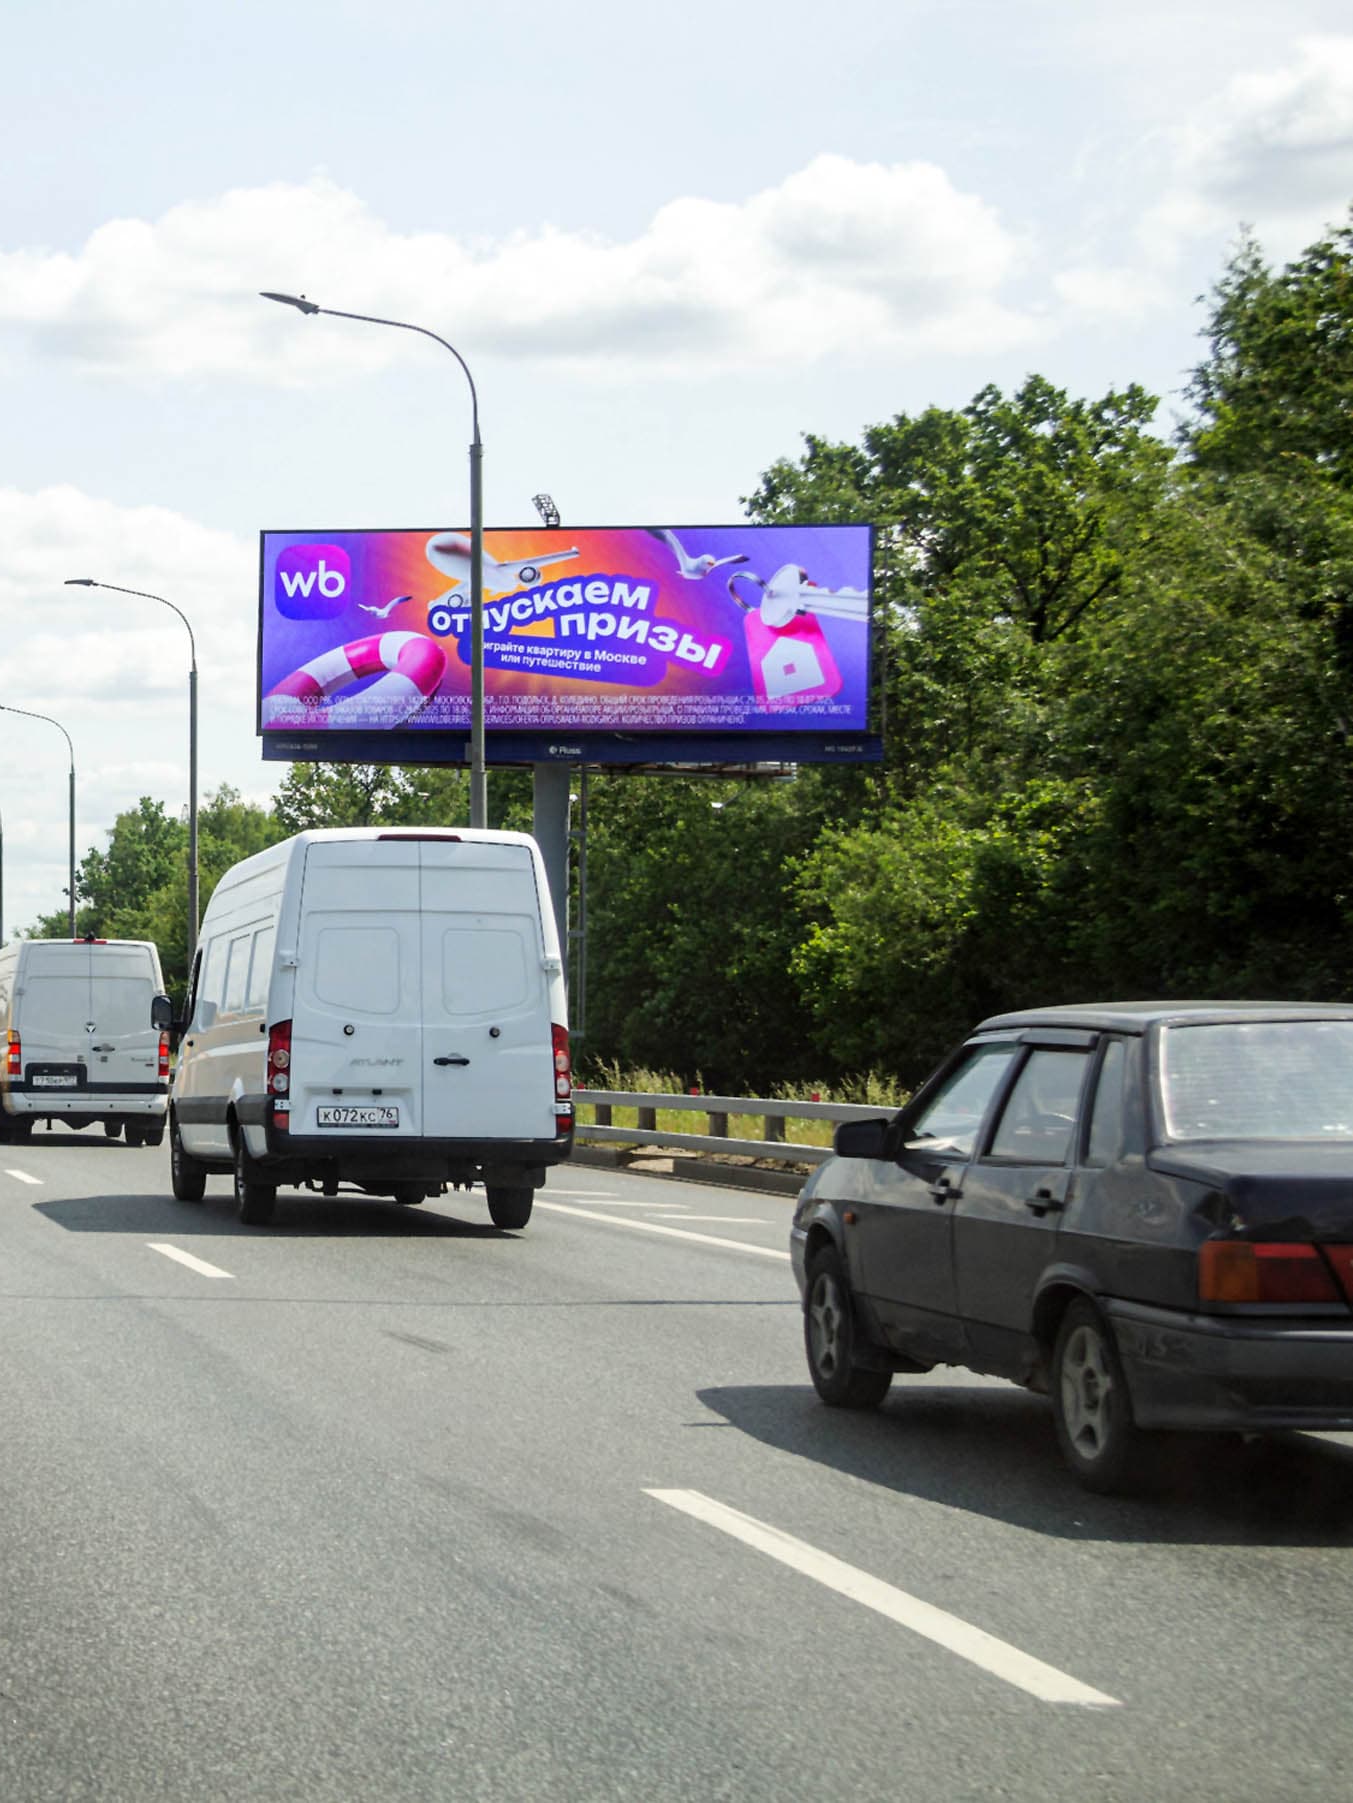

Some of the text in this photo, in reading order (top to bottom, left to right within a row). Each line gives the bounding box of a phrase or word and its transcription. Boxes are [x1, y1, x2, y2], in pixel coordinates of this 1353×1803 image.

[280, 560, 345, 598] wb
[526, 646, 582, 661] квартиру
[584, 651, 591, 659] в
[594, 651, 647, 665] Москве
[560, 613, 722, 669] призы
[501, 653, 602, 673] или путешествие
